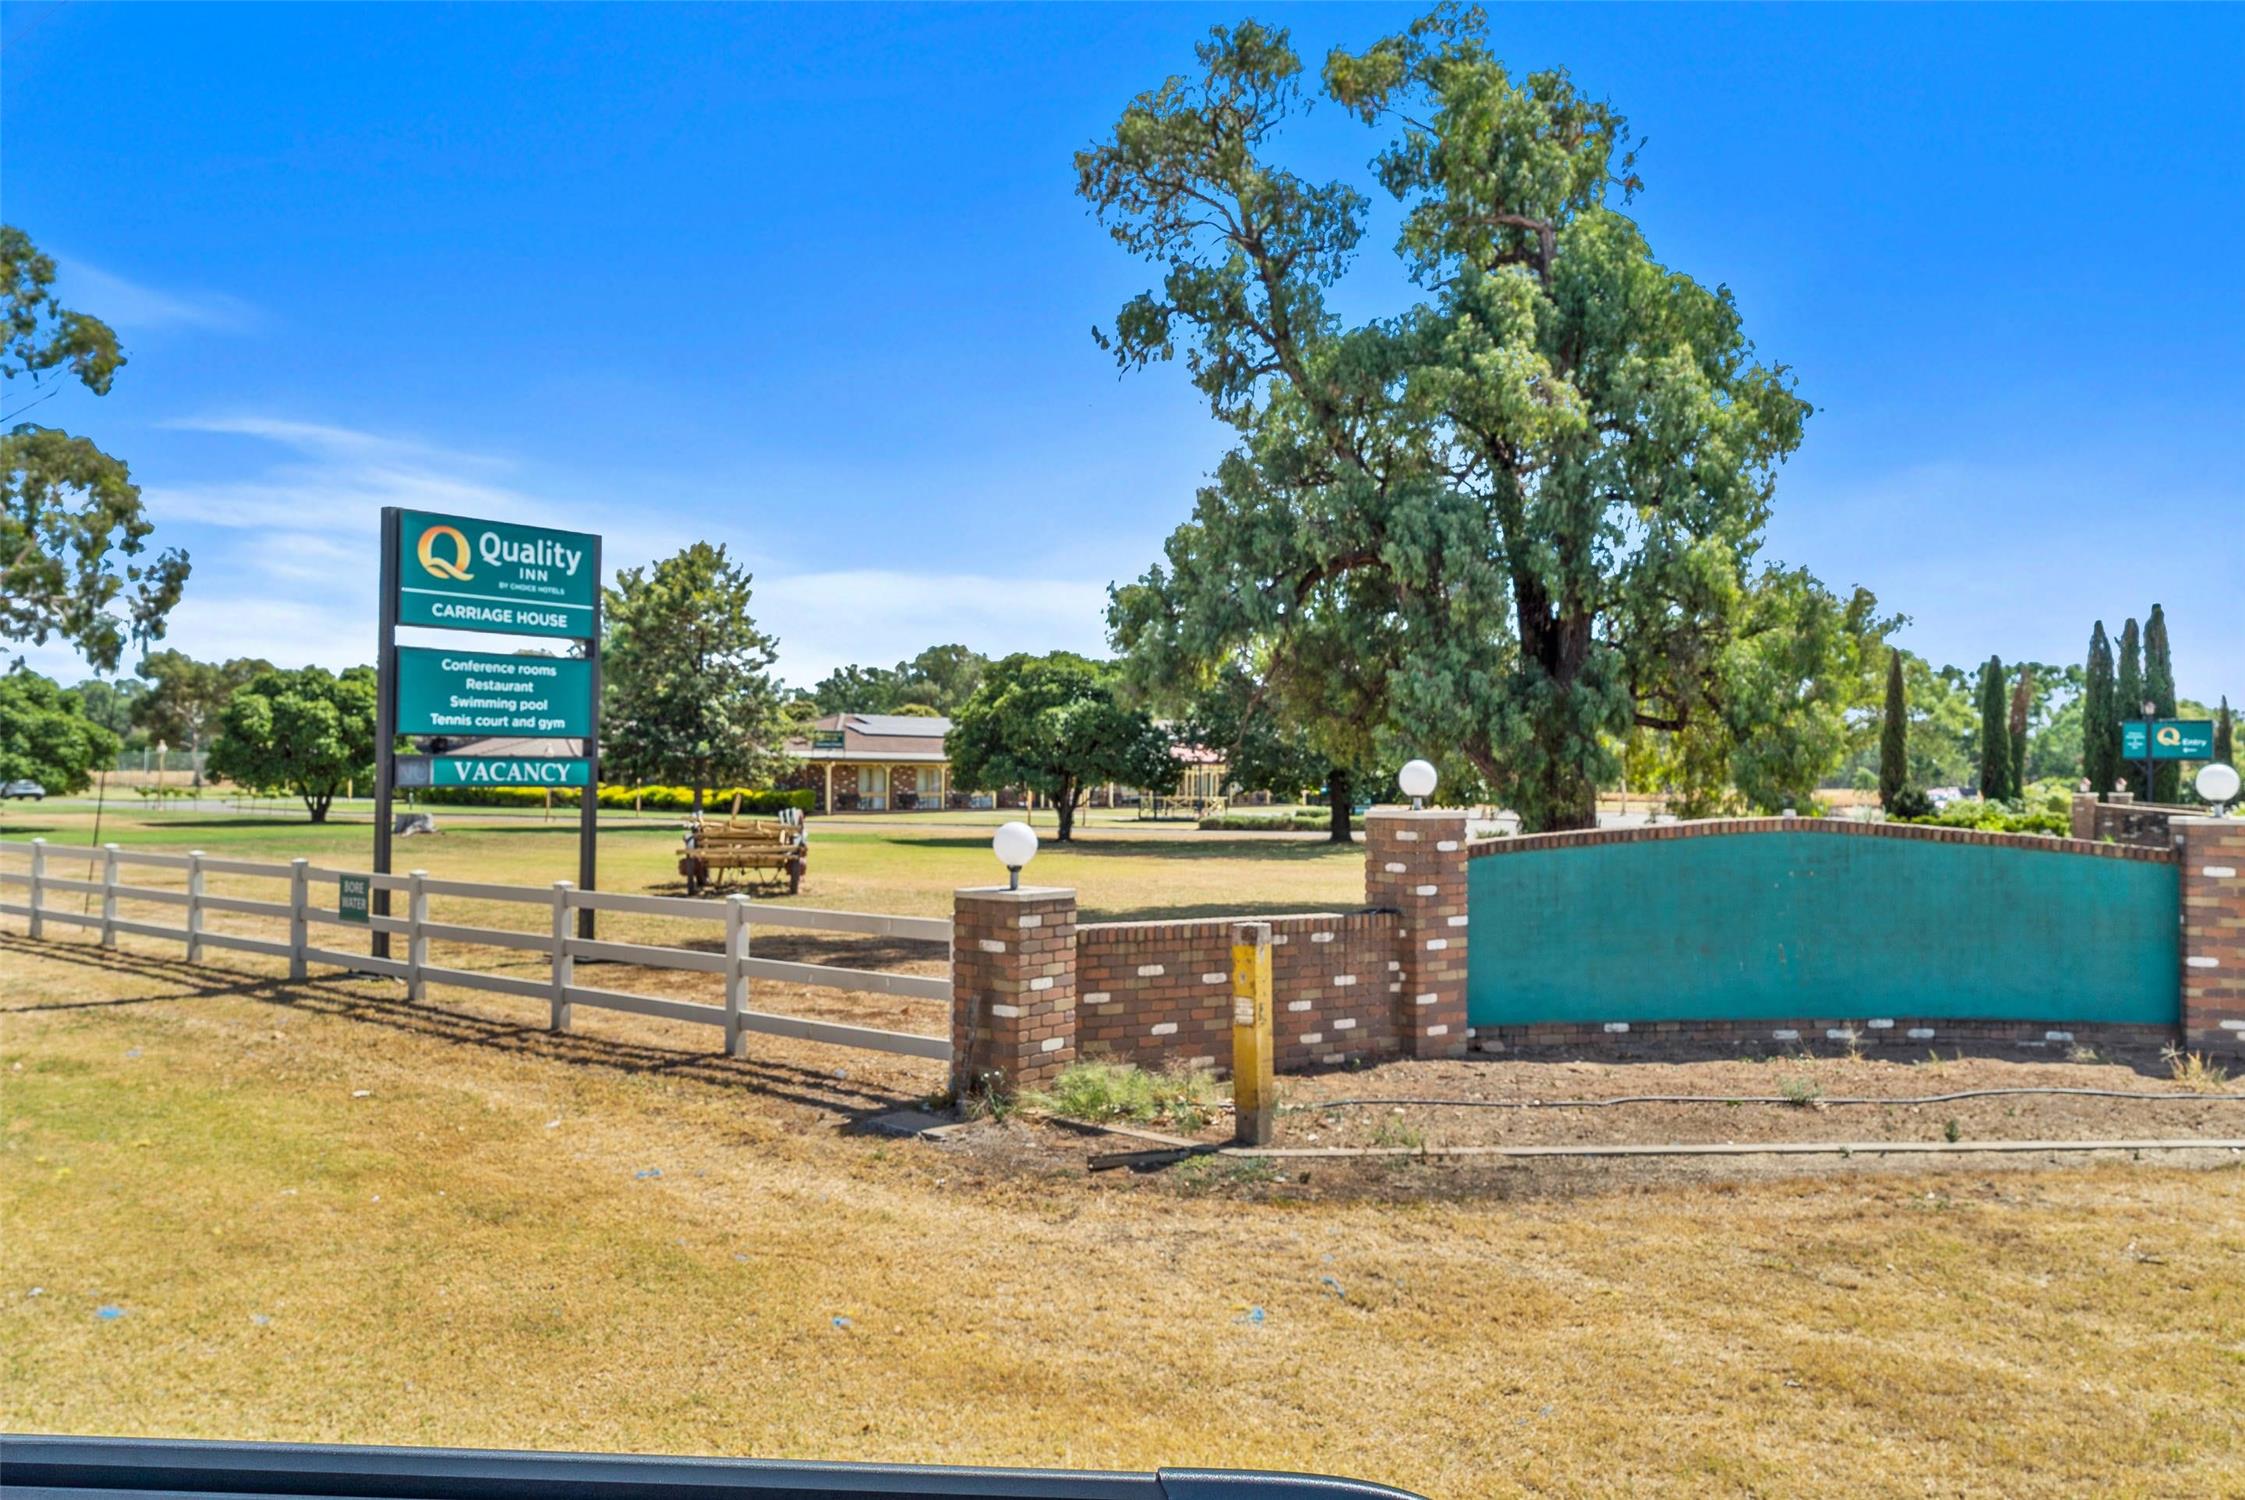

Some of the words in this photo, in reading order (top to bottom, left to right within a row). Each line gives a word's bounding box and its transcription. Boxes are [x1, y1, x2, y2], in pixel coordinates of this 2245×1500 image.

[479, 531, 582, 576] Quality
[519, 567, 548, 582] INN
[498, 581, 509, 589] BY
[510, 583, 537, 592] CHOICE
[538, 586, 565, 595] HOTELS
[432, 603, 512, 623] CARRIAGE
[516, 612, 568, 628] HOUSE
[441, 658, 515, 674] Conference
[518, 666, 557, 677] rooms
[466, 678, 534, 693] Restaurant
[450, 695, 516, 711] Swimming
[520, 699, 548, 711] pool
[430, 713, 472, 726] Tennis
[475, 716, 508, 727] court
[511, 716, 535, 728] and
[538, 718, 566, 730] gym
[2182, 738, 2208, 747] Entry
[454, 761, 571, 782] VACANCY
[343, 880, 365, 894] BORE
[342, 896, 367, 910] WATER
